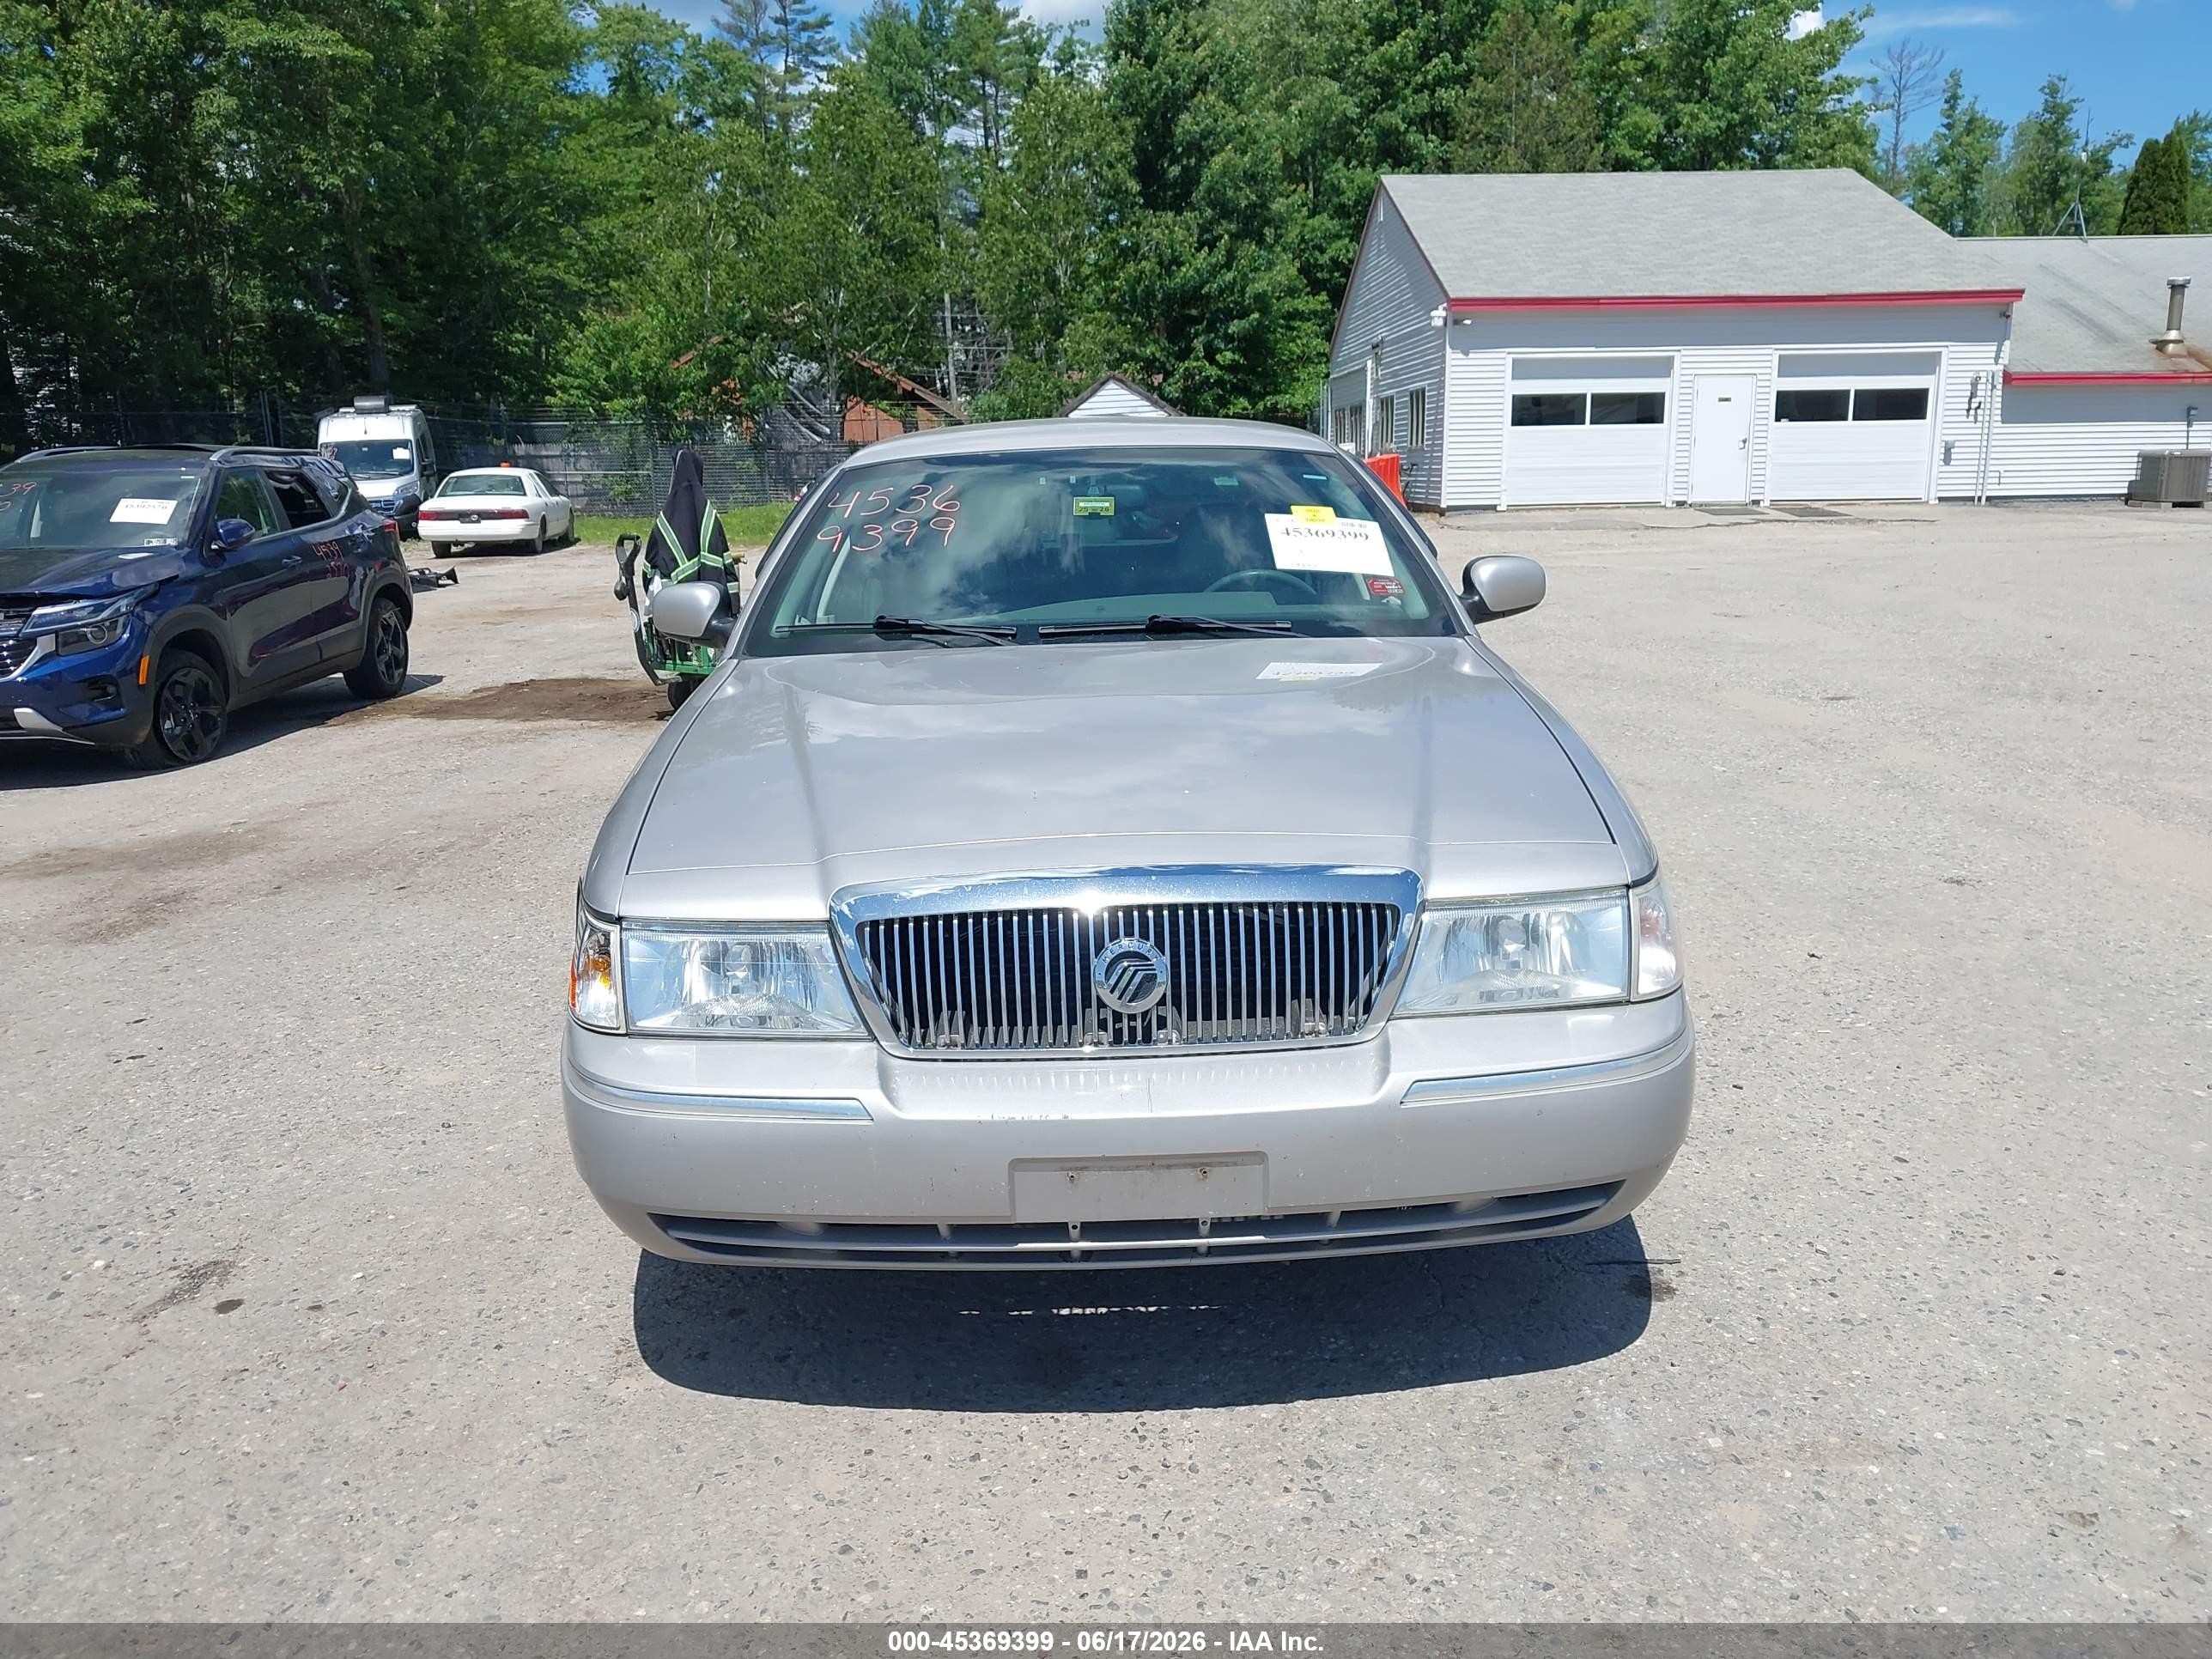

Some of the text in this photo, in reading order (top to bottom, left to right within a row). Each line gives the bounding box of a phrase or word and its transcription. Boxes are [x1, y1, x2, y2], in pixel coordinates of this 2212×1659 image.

[828, 484, 961, 518] 4536
[817, 517, 956, 552] 9399
[1280, 526, 1370, 542] 45369399
[312, 541, 344, 562] 4539
[1102, 942, 1158, 963] MERCURY
